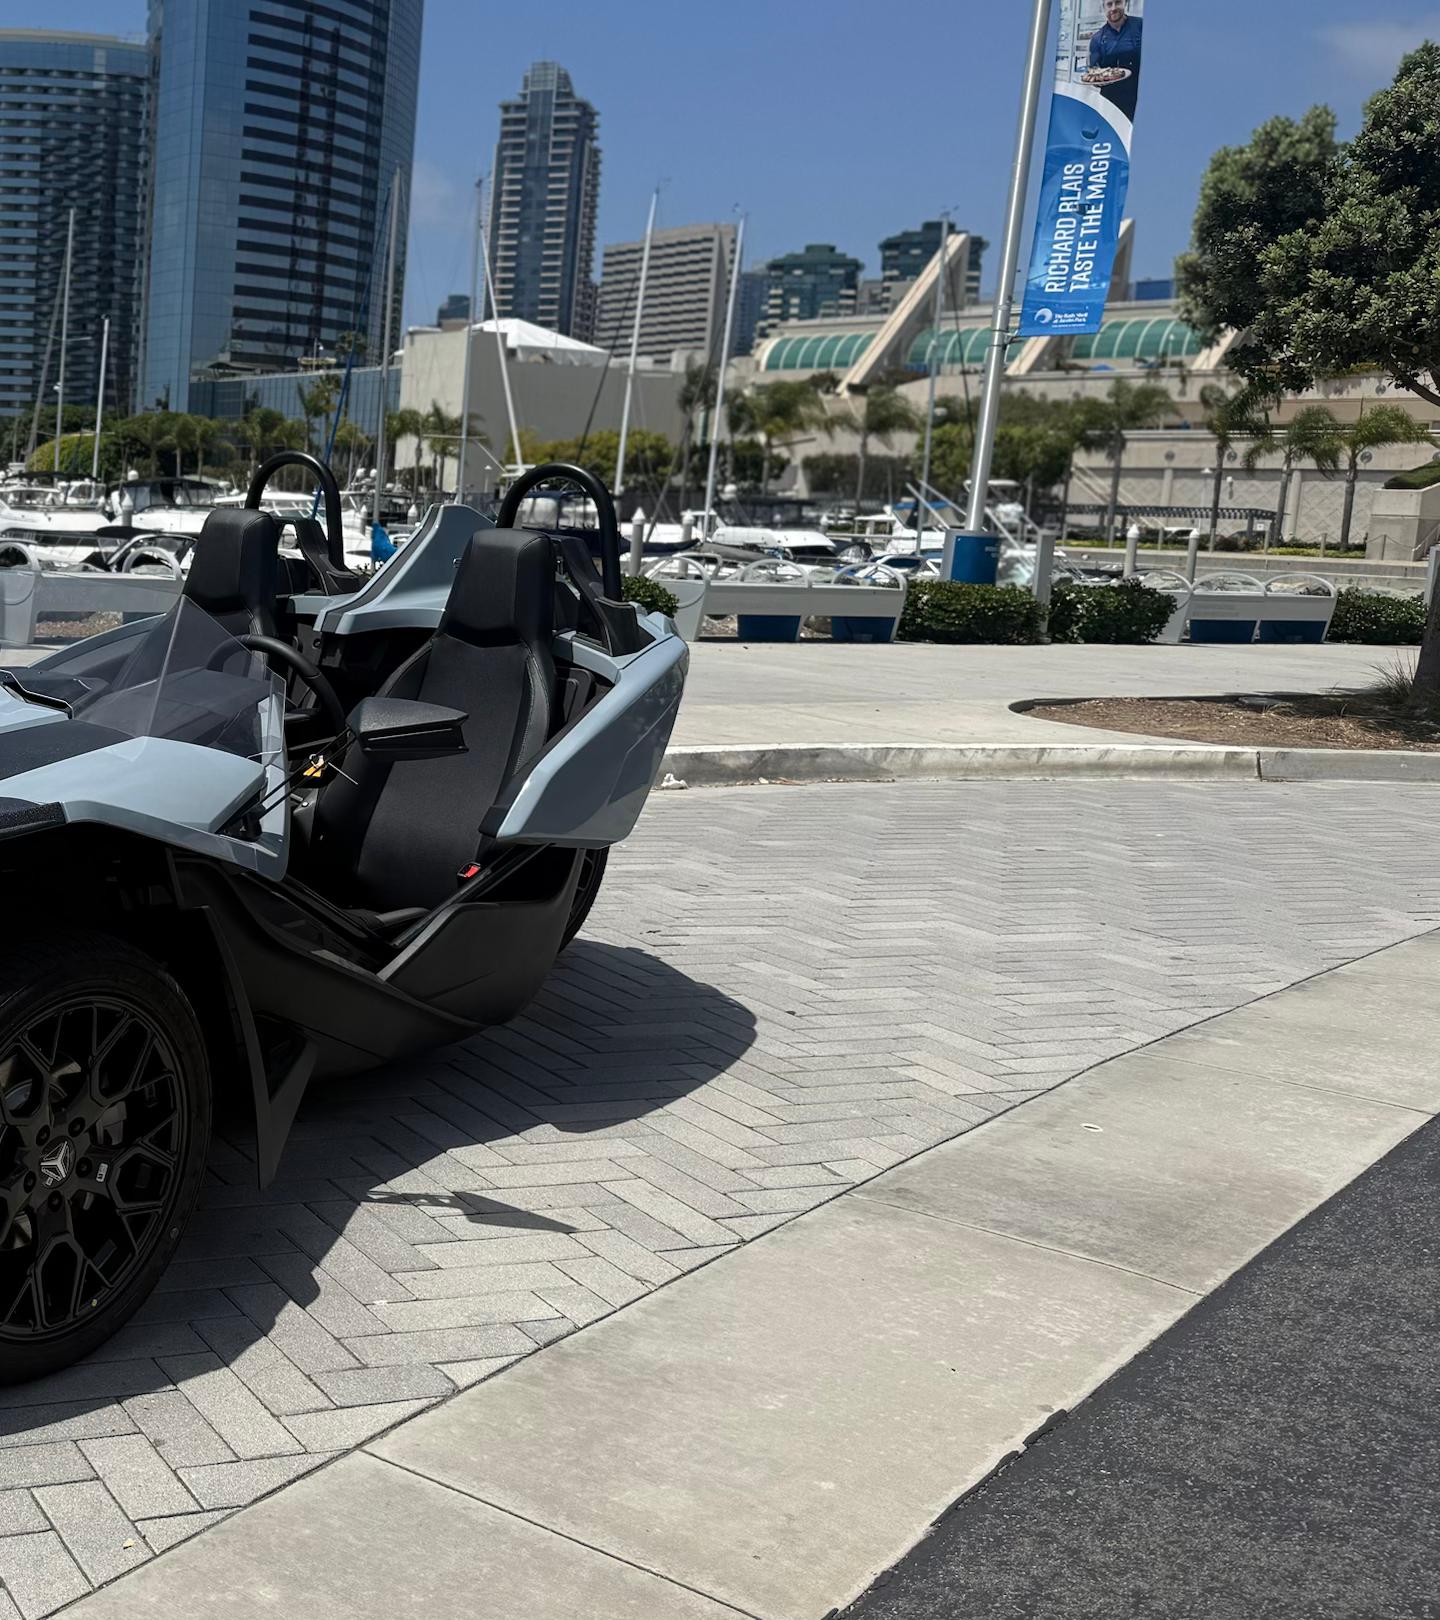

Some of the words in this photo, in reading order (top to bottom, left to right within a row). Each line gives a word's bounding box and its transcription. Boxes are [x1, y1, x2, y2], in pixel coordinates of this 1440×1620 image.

[1058, 163, 1085, 213] BLAIS
[1086, 142, 1112, 200] MAGIC
[1080, 203, 1103, 238] THE
[1045, 218, 1077, 293] RICHARD
[1069, 240, 1097, 293] TASTE
